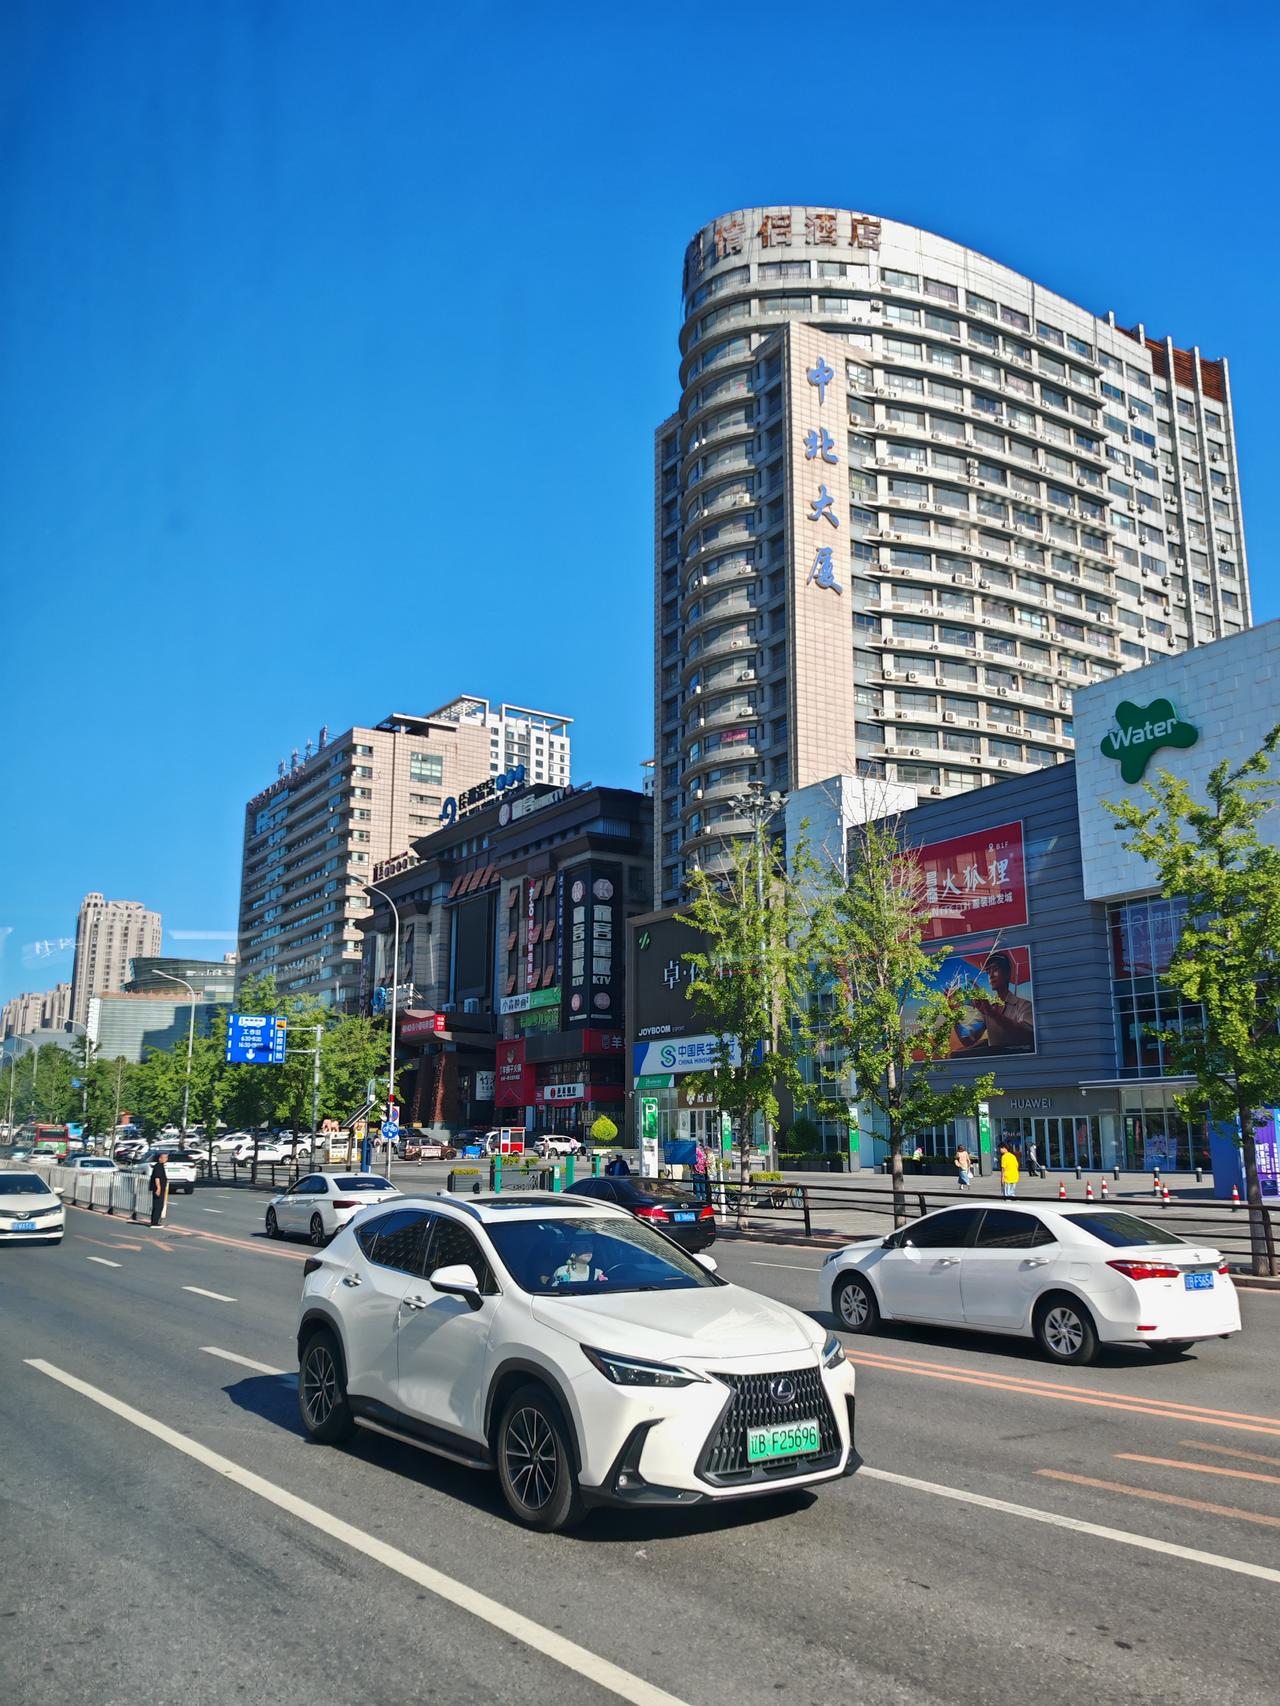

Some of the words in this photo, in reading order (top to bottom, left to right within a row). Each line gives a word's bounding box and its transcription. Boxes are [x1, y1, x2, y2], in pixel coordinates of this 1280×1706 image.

[802, 355, 843, 595] 中北大厦
[1108, 718, 1178, 751] Water
[941, 858, 1010, 899] 火狐狸
[638, 1024, 671, 1037] JOYBOOM
[678, 1039, 736, 1058] 中国民生行
[1010, 1097, 1053, 1110] HUAWEI
